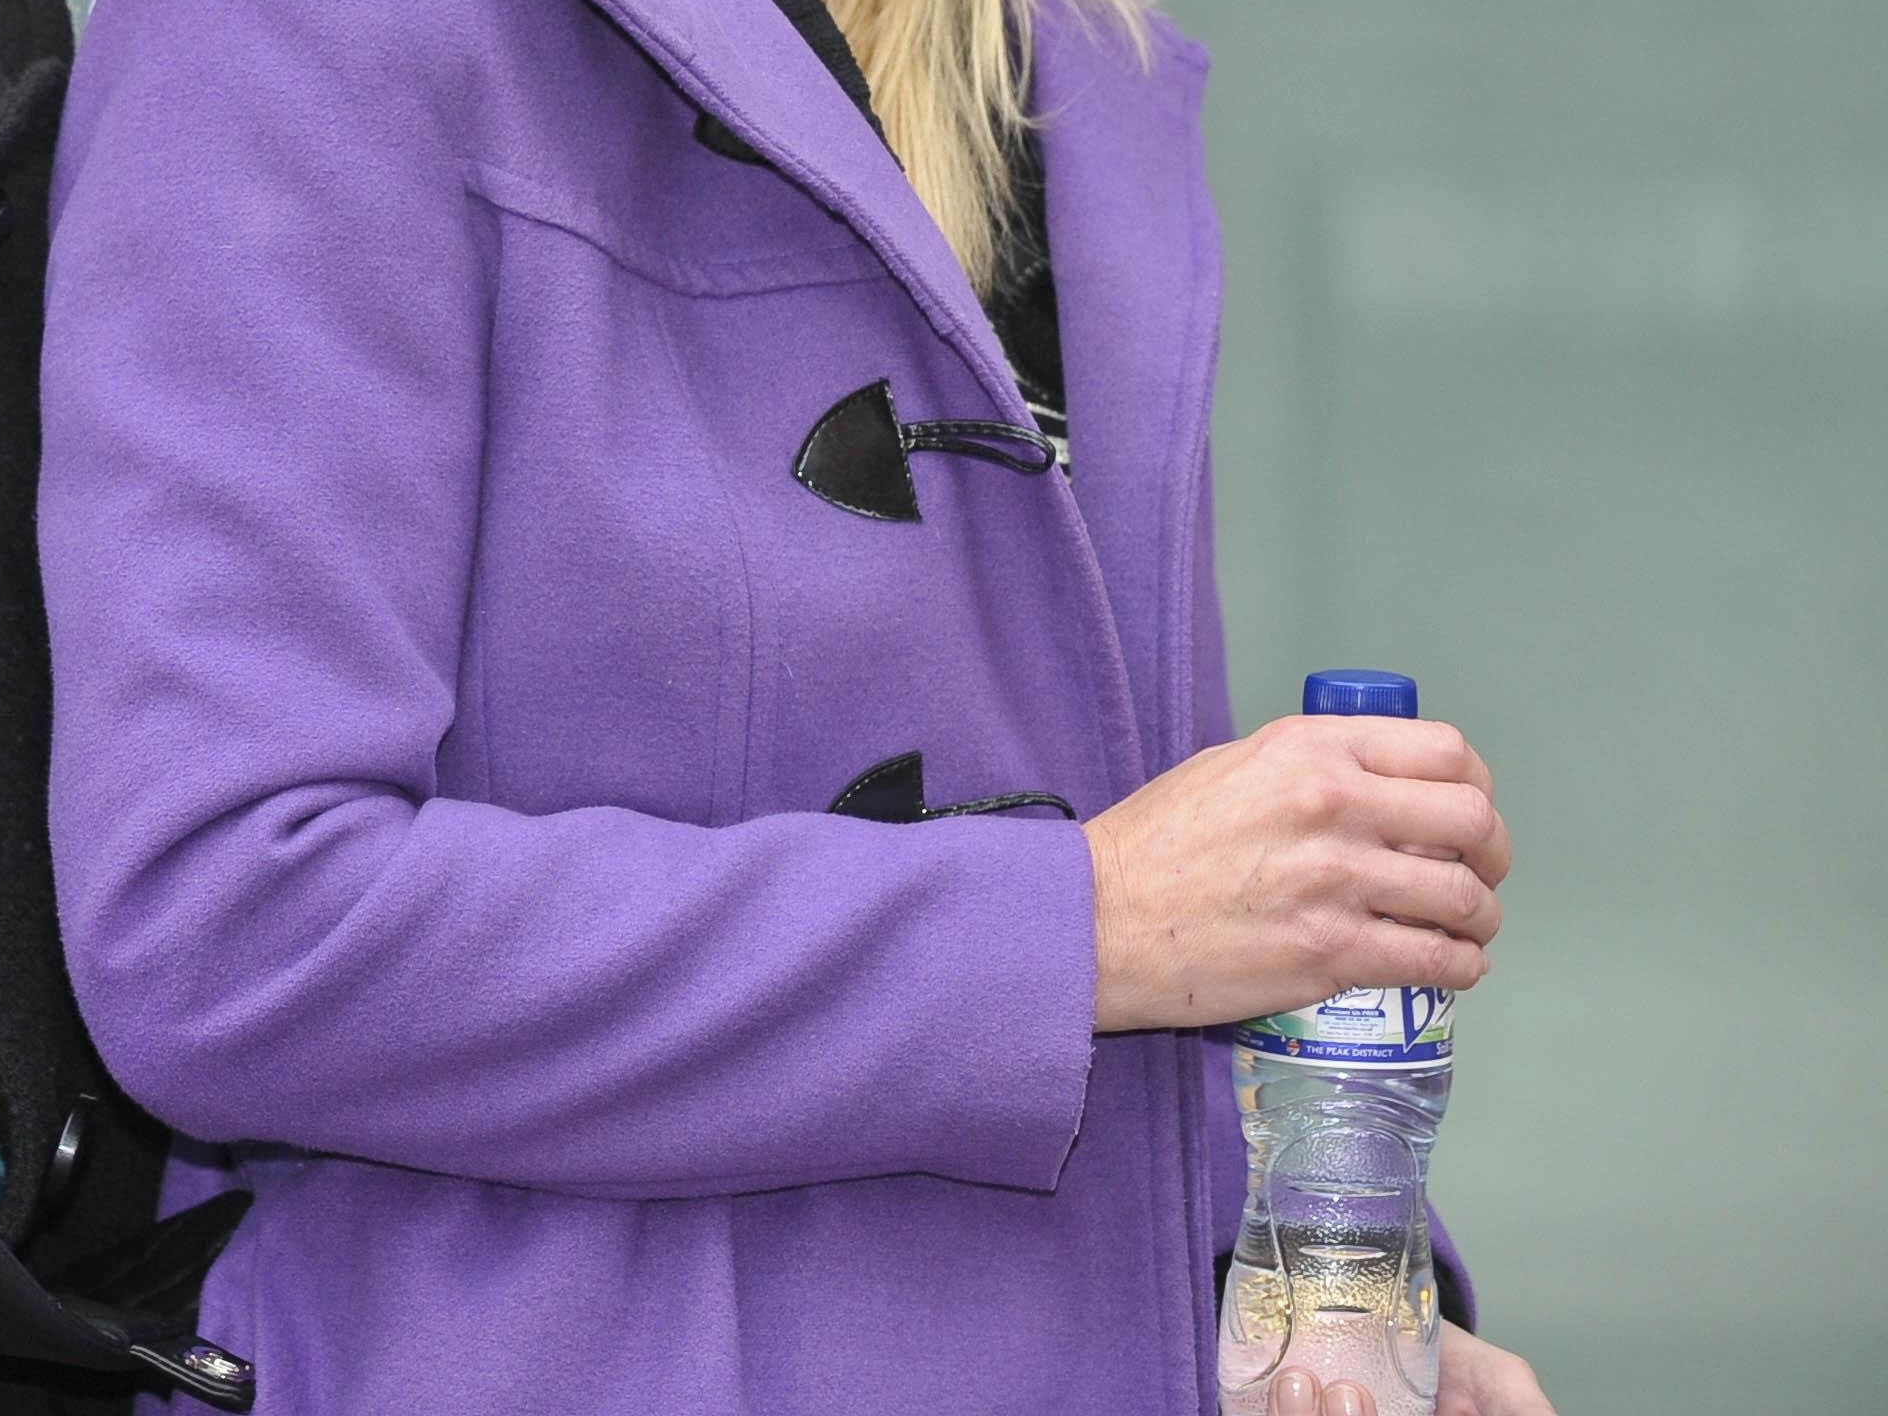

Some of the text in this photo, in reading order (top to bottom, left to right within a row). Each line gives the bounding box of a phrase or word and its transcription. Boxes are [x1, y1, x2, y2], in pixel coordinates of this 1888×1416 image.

[1306, 1045, 1394, 1058] THE PEAK DISTRICT
